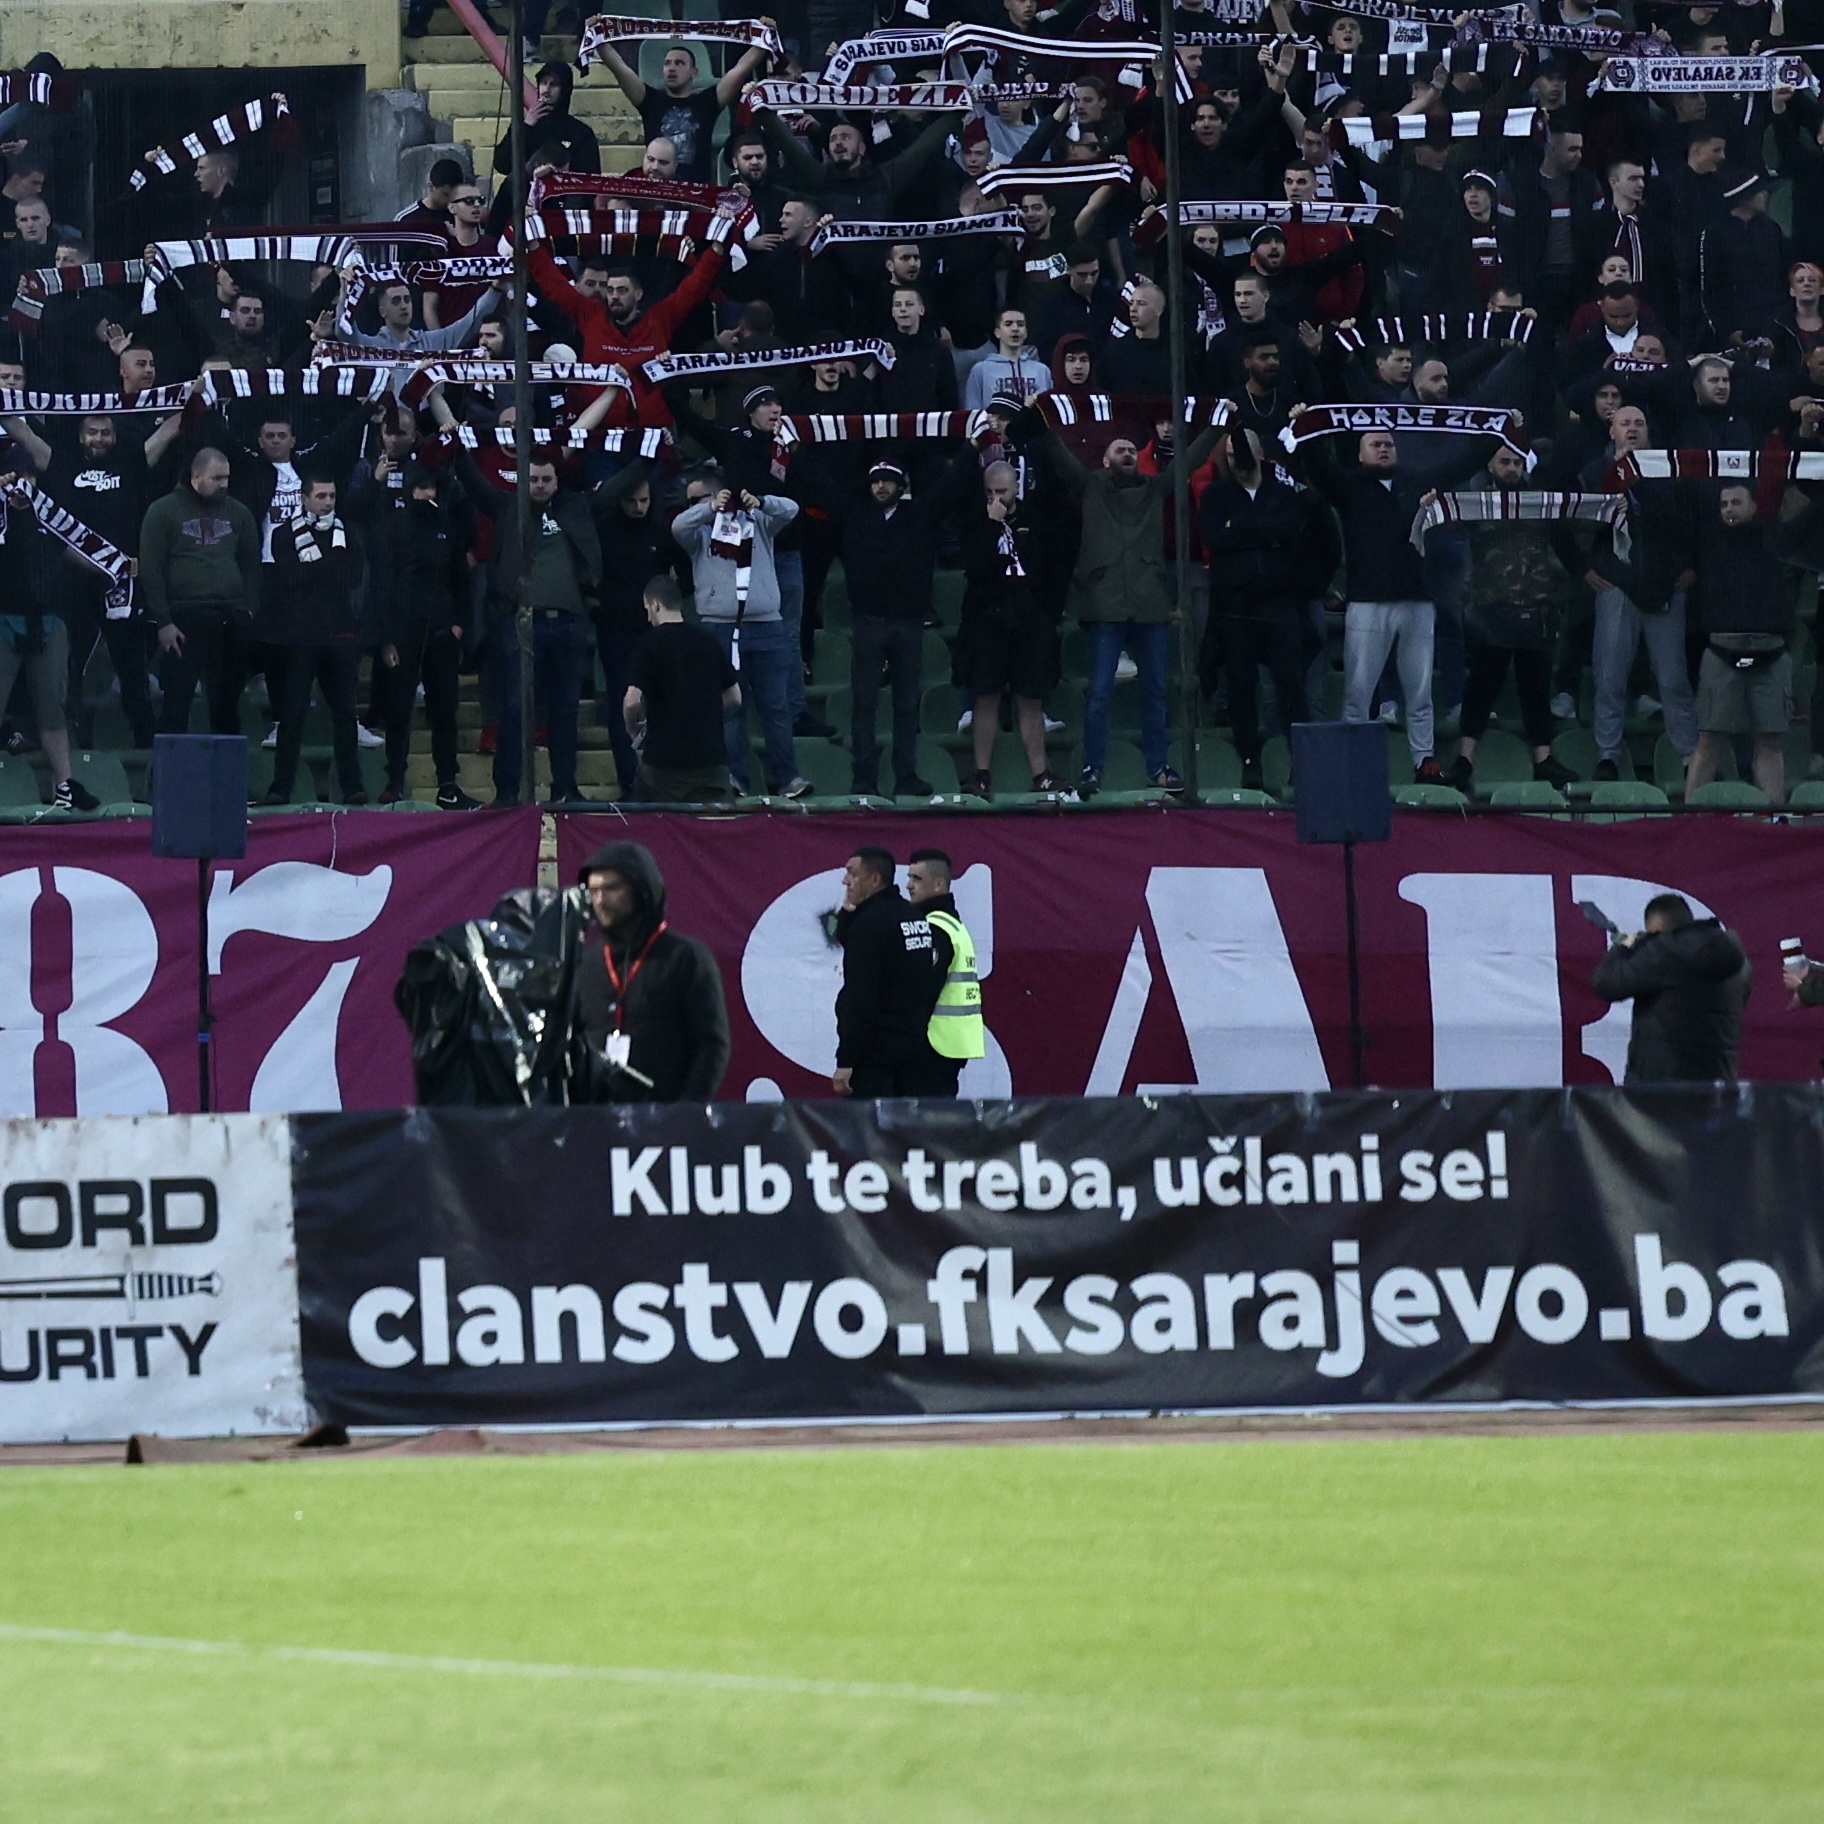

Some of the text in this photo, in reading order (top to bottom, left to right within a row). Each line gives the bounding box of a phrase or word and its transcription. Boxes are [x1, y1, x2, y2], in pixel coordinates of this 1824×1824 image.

[1522, 24, 1623, 46] SARAJEVO
[767, 82, 973, 106] HORDE ZLA
[662, 342, 849, 373] SARAJEVO SIAMO
[1331, 408, 1508, 430] HORDE ZLA
[612, 1129, 1510, 1221] Klub te treba, učlani se!
[349, 1233, 1791, 1379] clanstvo.fksarajevo.ba
